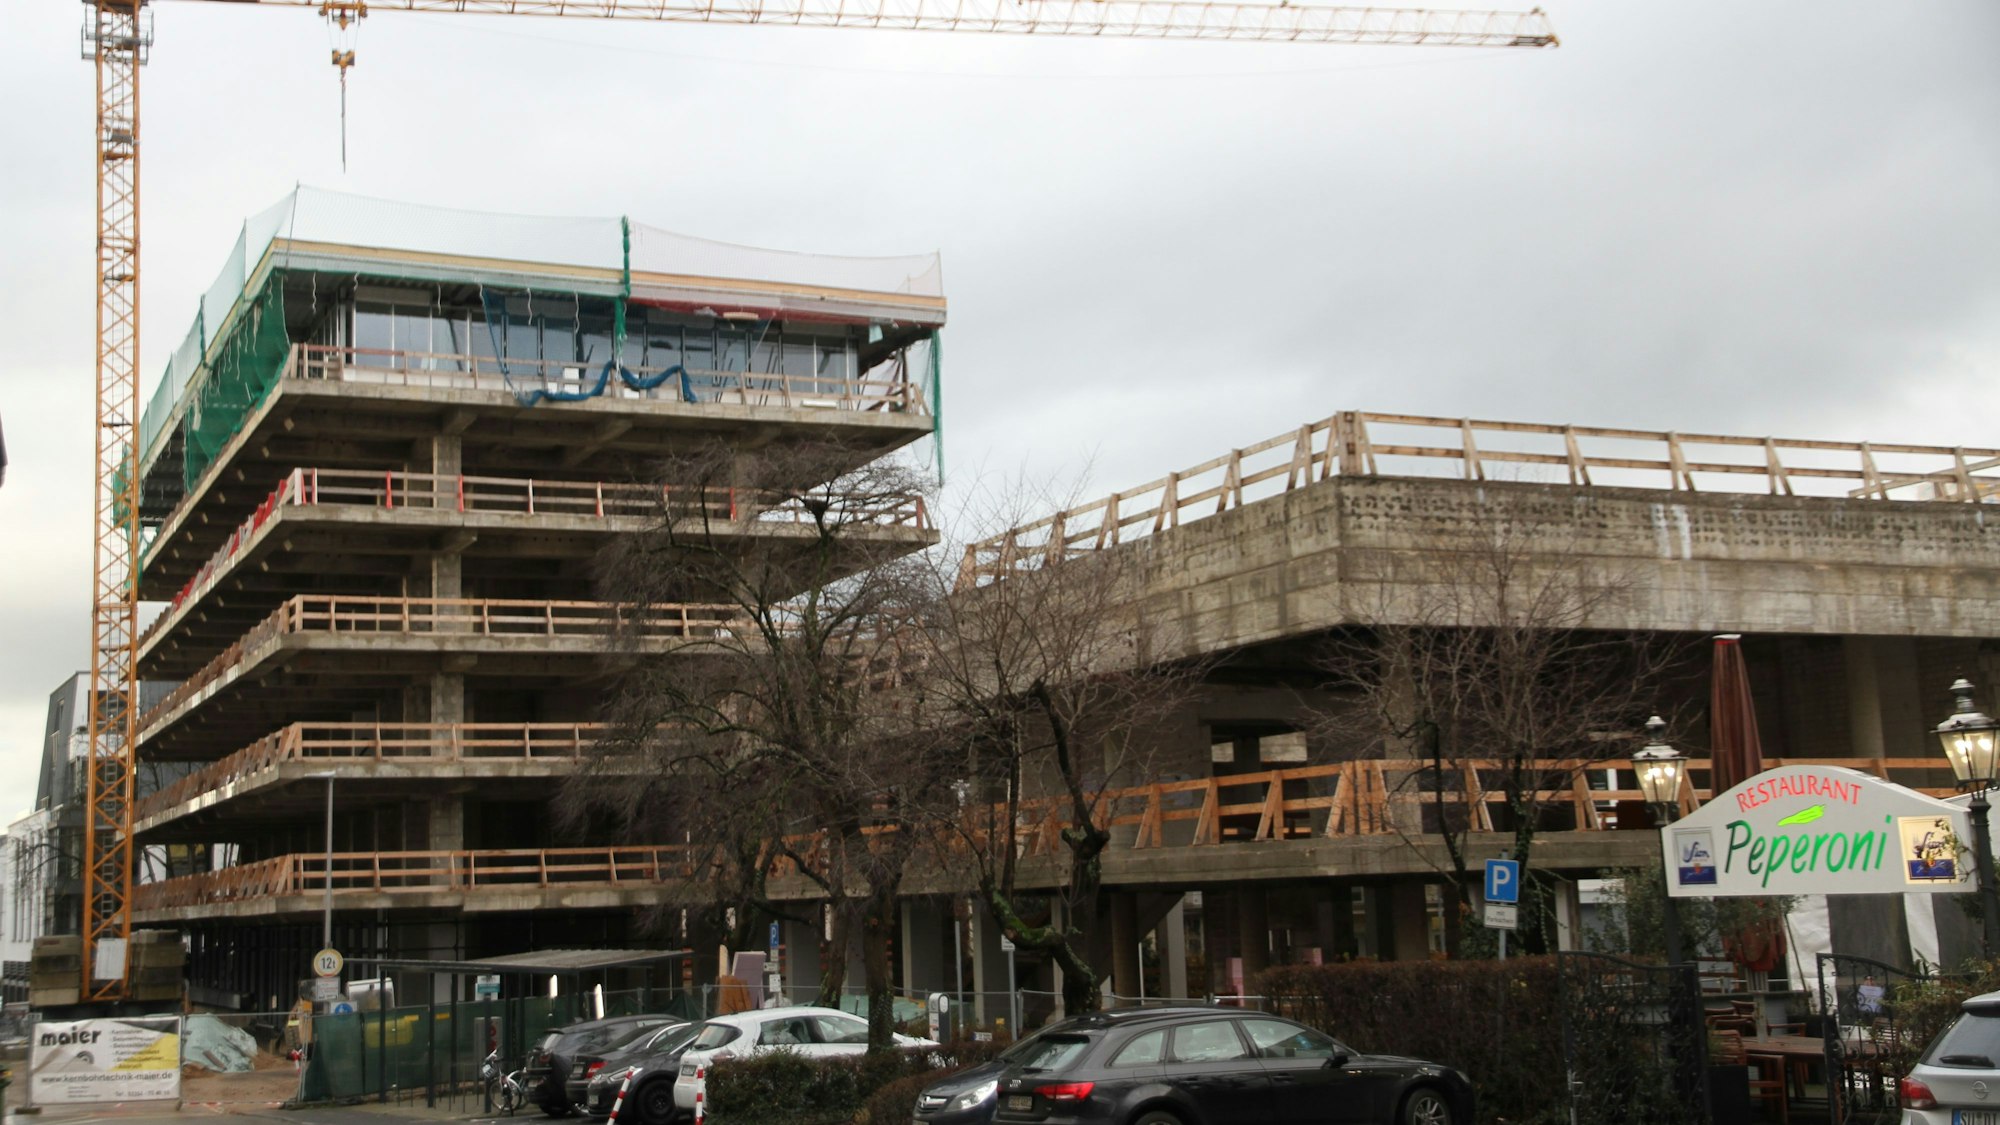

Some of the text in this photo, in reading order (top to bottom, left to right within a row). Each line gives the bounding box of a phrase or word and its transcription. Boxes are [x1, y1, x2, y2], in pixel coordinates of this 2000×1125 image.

[1736, 774, 1862, 813] RESTAURANT
[1725, 814, 1892, 888] Peperoni
[1492, 866, 1510, 896] P
[41, 1025, 102, 1046] maier
